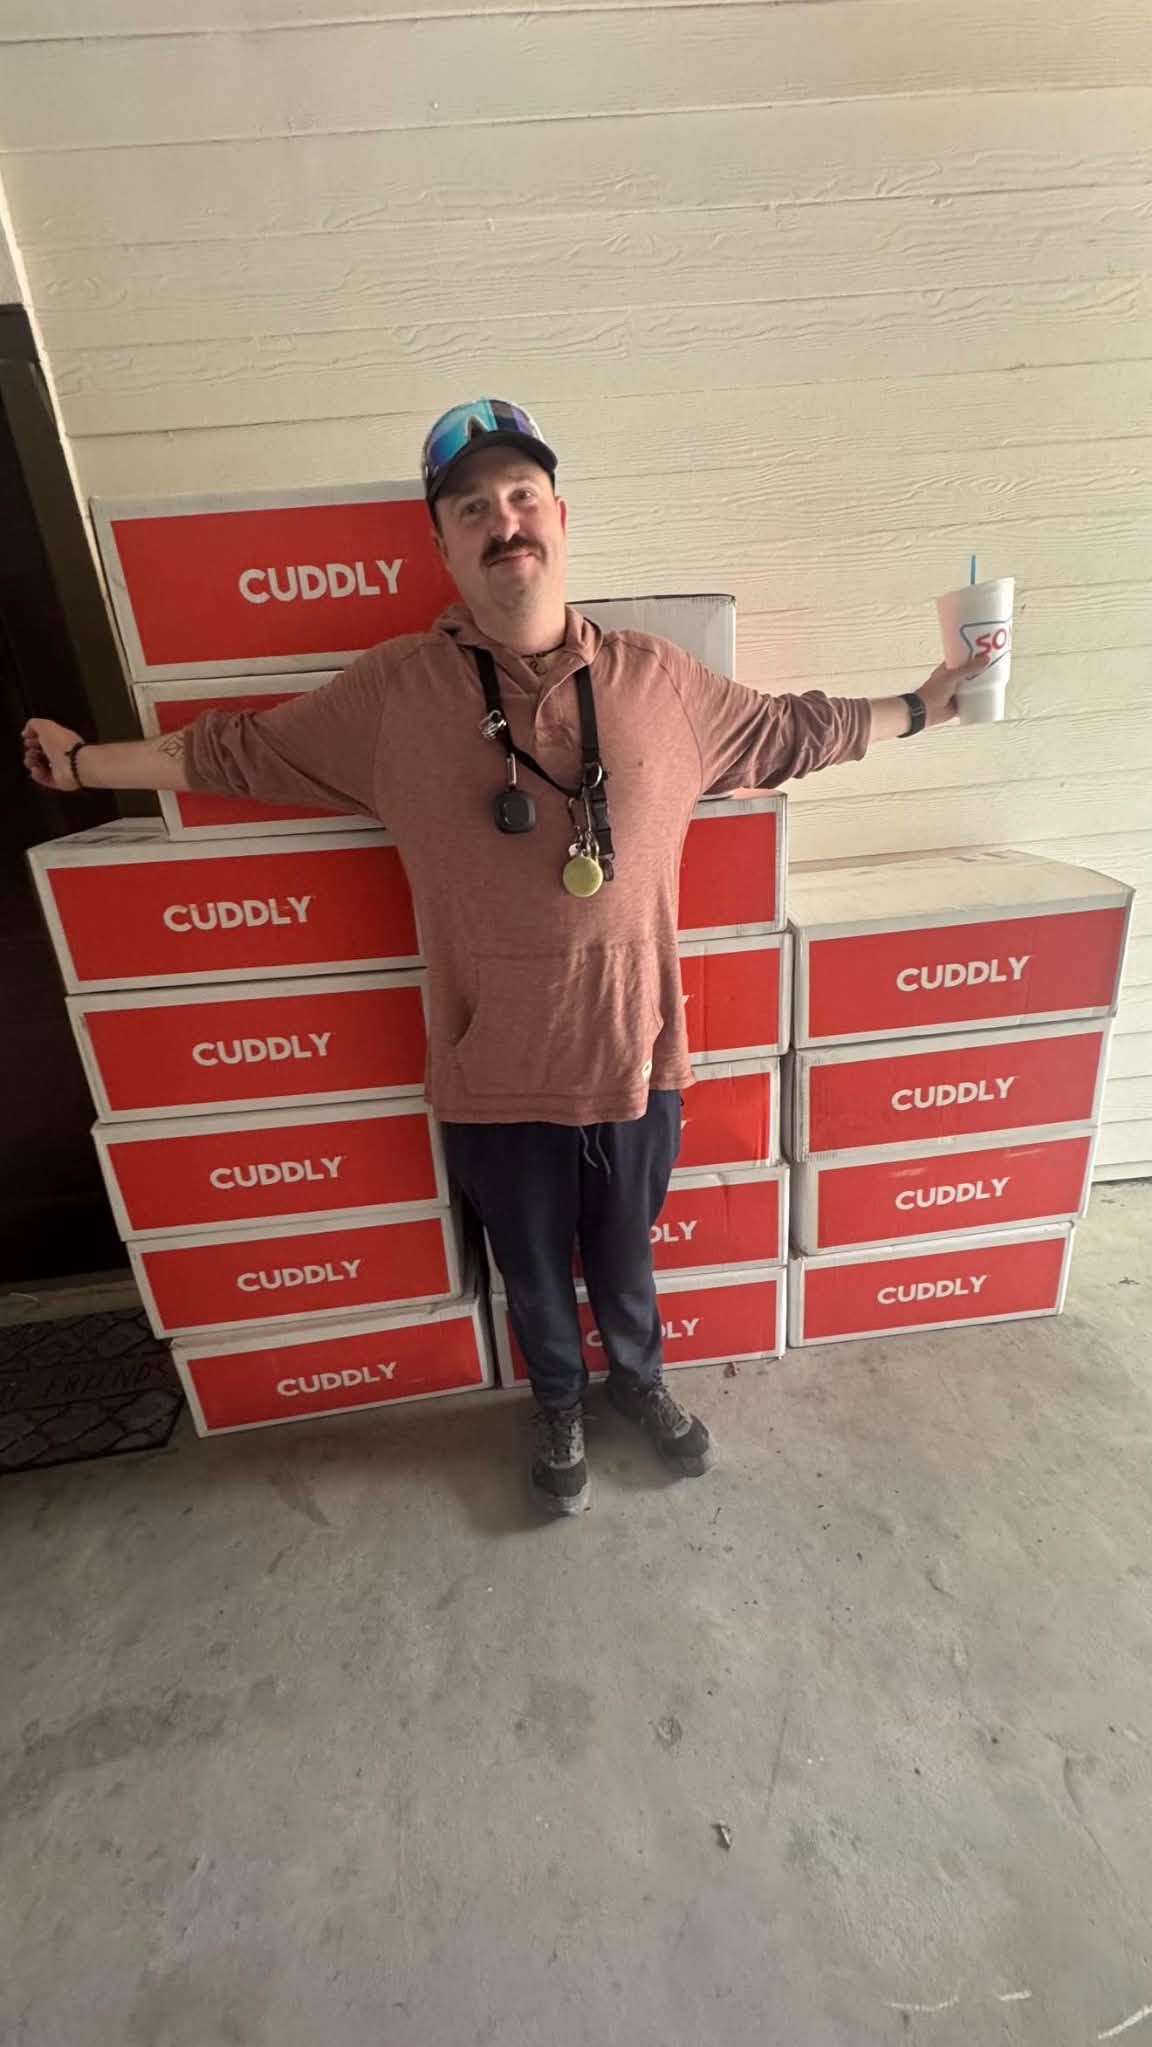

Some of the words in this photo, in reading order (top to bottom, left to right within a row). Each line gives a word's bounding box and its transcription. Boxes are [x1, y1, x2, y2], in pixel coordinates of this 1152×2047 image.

[238, 558, 403, 604] CUDDLY
[976, 628, 1009, 657] SO
[162, 895, 312, 932] CUDDLY
[896, 955, 1031, 992] CUDDLY
[191, 1032, 331, 1067] CUDDLY
[891, 1075, 1016, 1111] CUDDLY
[209, 1155, 342, 1190] CUDDLY
[895, 1176, 1010, 1210] CUDDLY
[649, 1220, 698, 1244] DLY
[236, 1259, 361, 1292] CUDDLY
[876, 1274, 988, 1305] CUDDLY
[586, 1317, 700, 1347] CLY
[276, 1361, 397, 1397] CUDDLY
